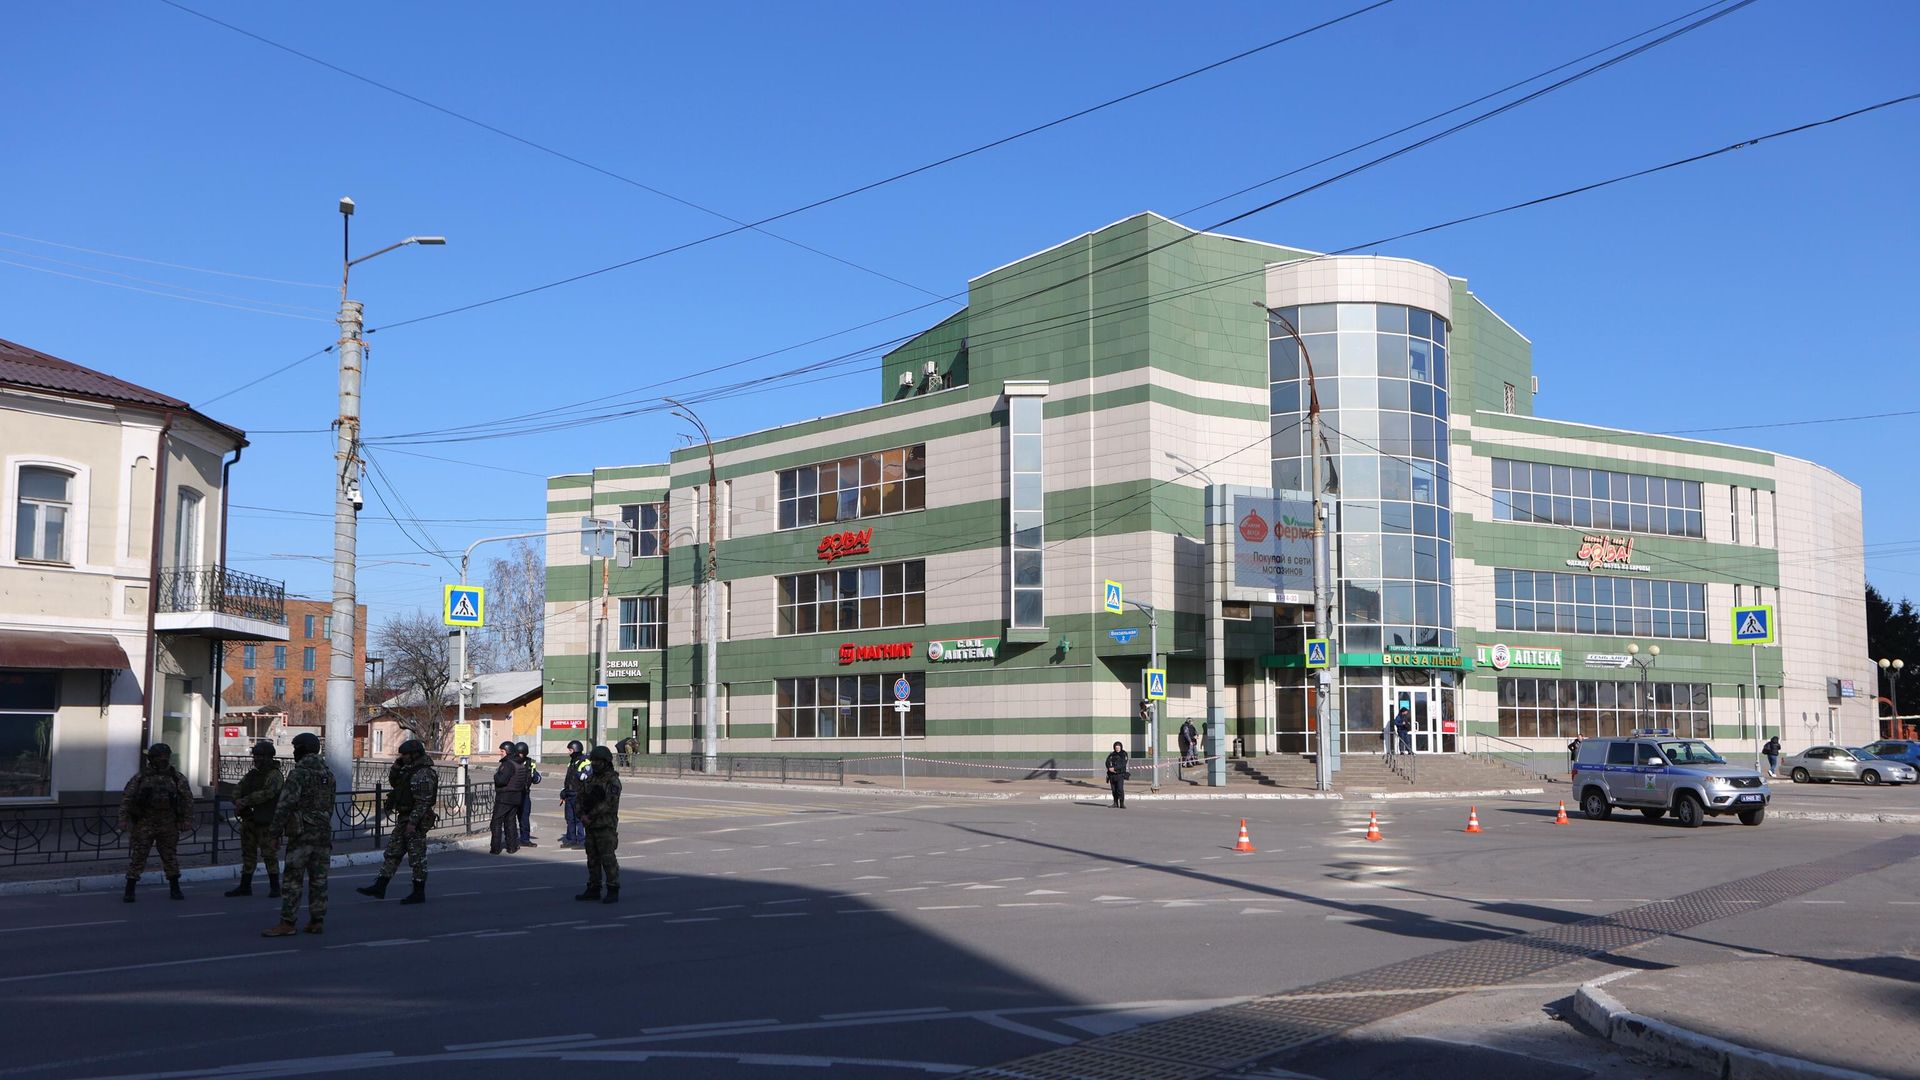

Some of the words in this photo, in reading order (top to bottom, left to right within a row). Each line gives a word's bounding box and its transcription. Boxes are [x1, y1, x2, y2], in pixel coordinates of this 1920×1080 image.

[1253, 552, 1286, 565] Покупай
[1294, 557, 1312, 566] сети
[1263, 566, 1303, 576] магазинов
[856, 642, 913, 660] МАГНИТ
[944, 647, 994, 660] АПТЕКА
[1515, 650, 1561, 665] АПТЕКА
[606, 660, 639, 668] СВЕЖАЯ
